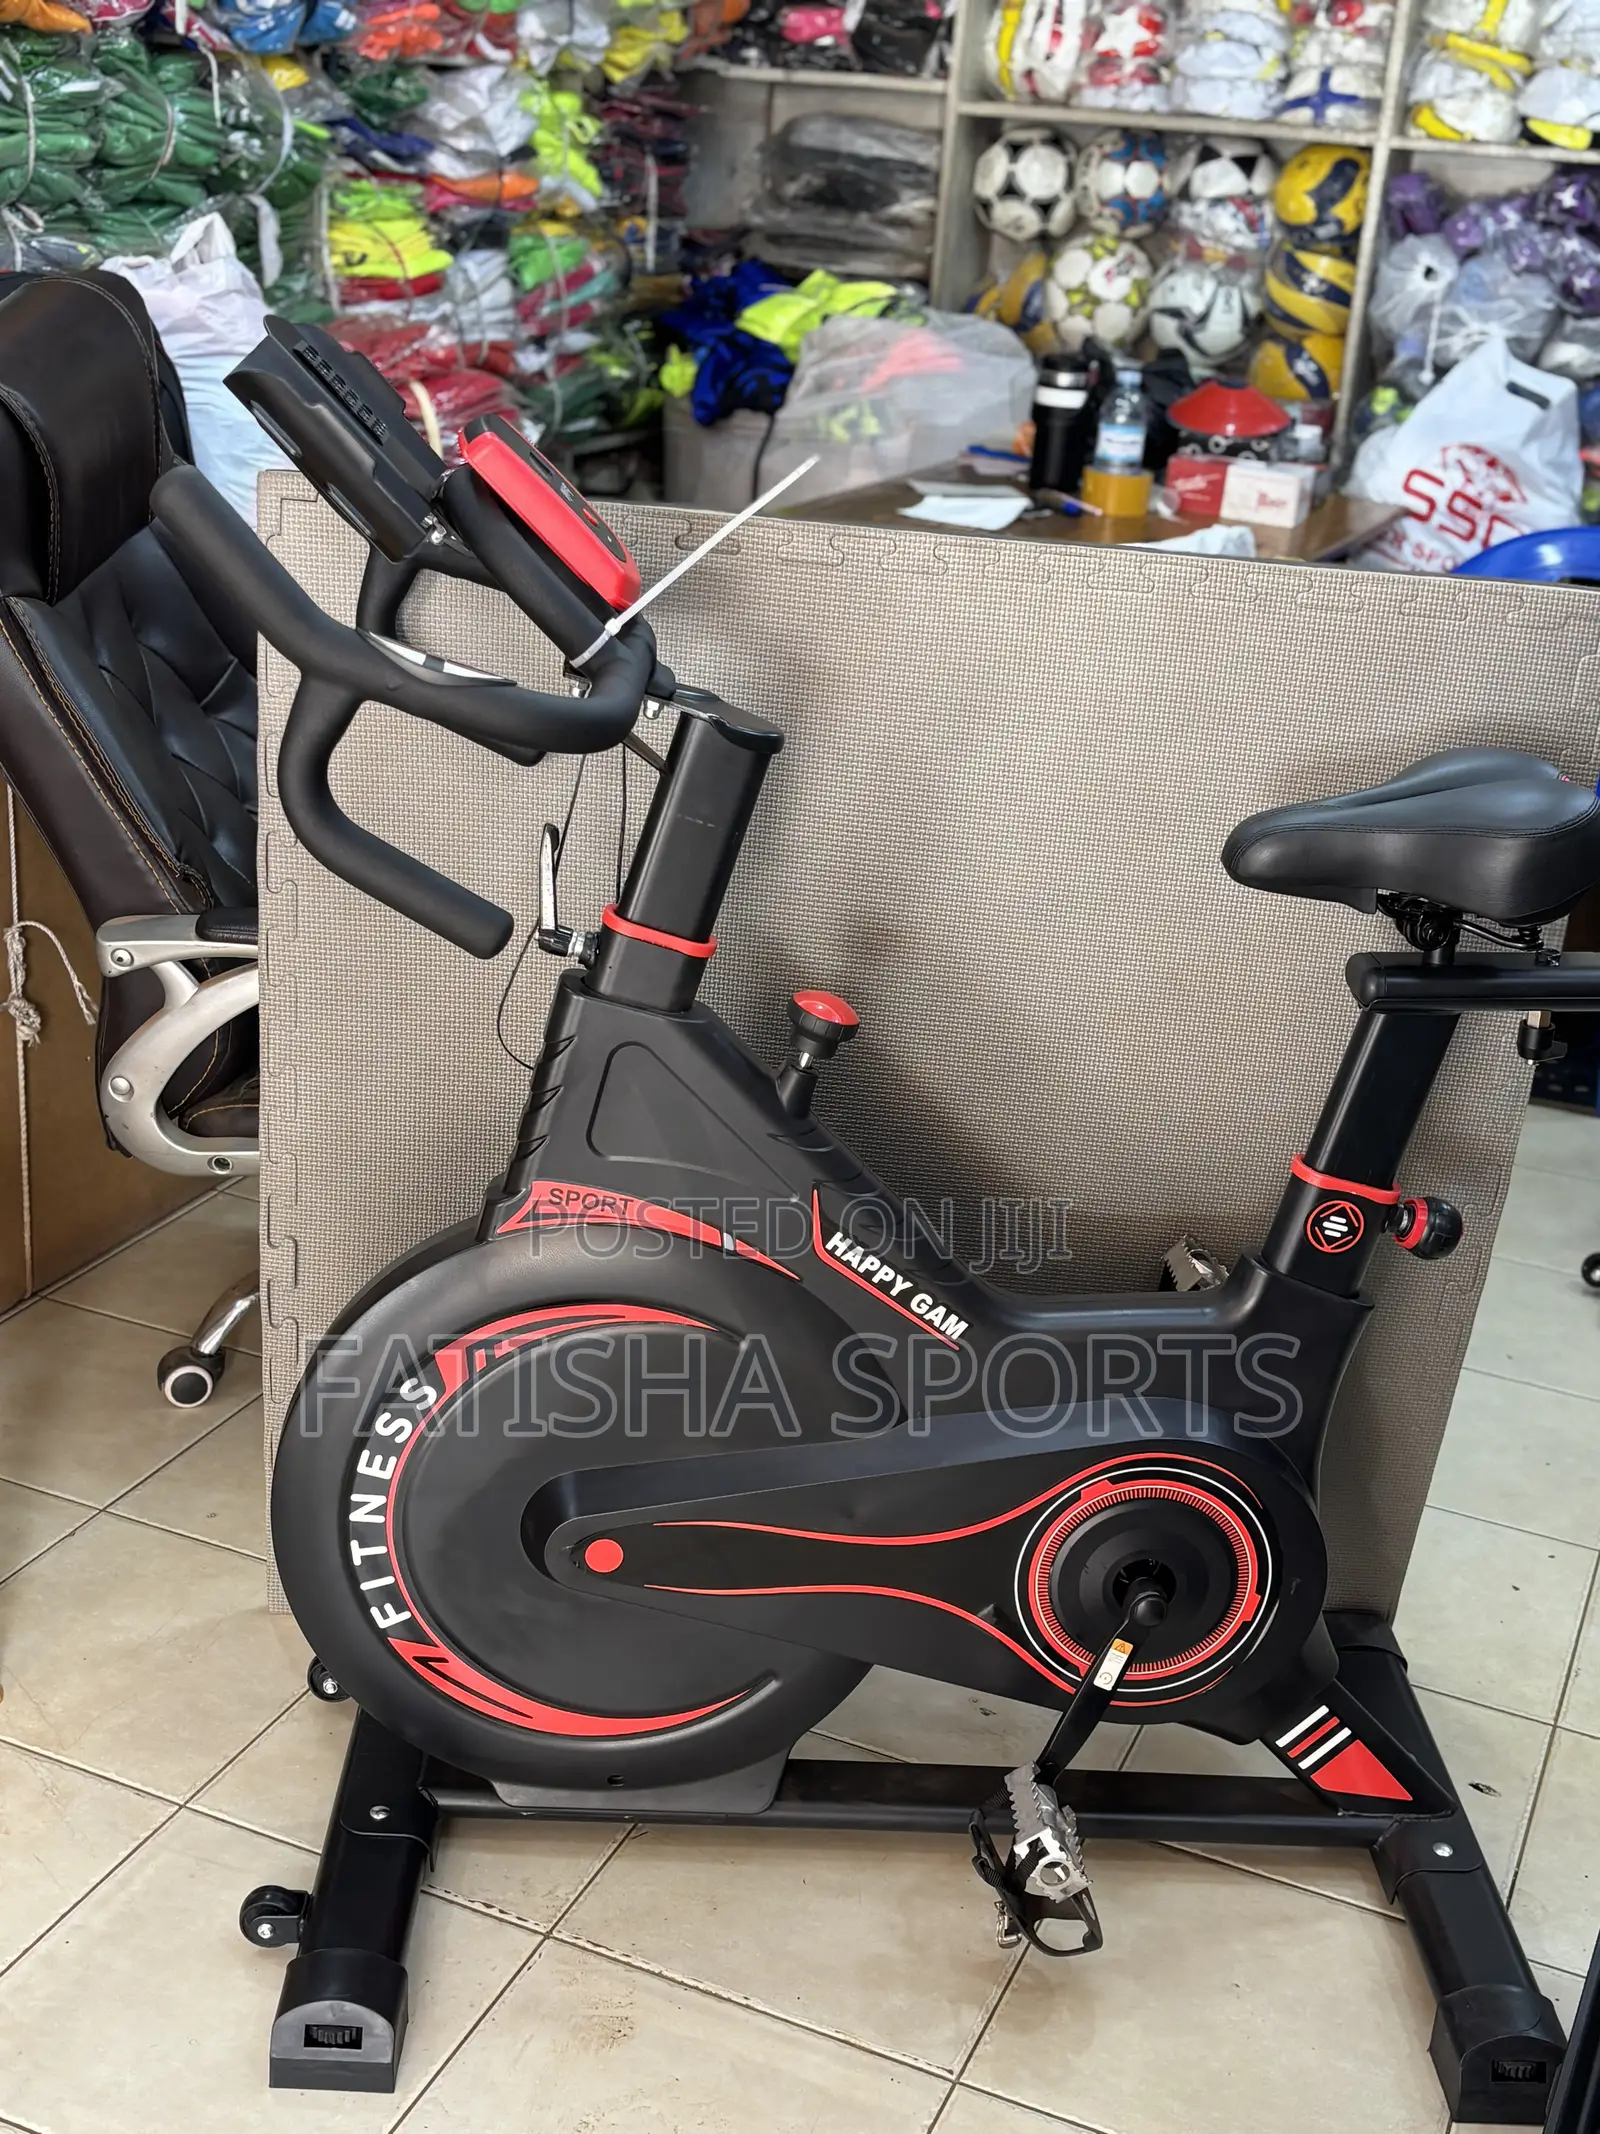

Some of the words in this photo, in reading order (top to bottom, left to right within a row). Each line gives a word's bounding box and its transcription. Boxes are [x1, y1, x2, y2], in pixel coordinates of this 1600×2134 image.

[548, 1187, 634, 1216] SPORT
[824, 1231, 914, 1297] HAPPY
[909, 1292, 969, 1341] GAM
[349, 1377, 438, 1630] FITNESS
